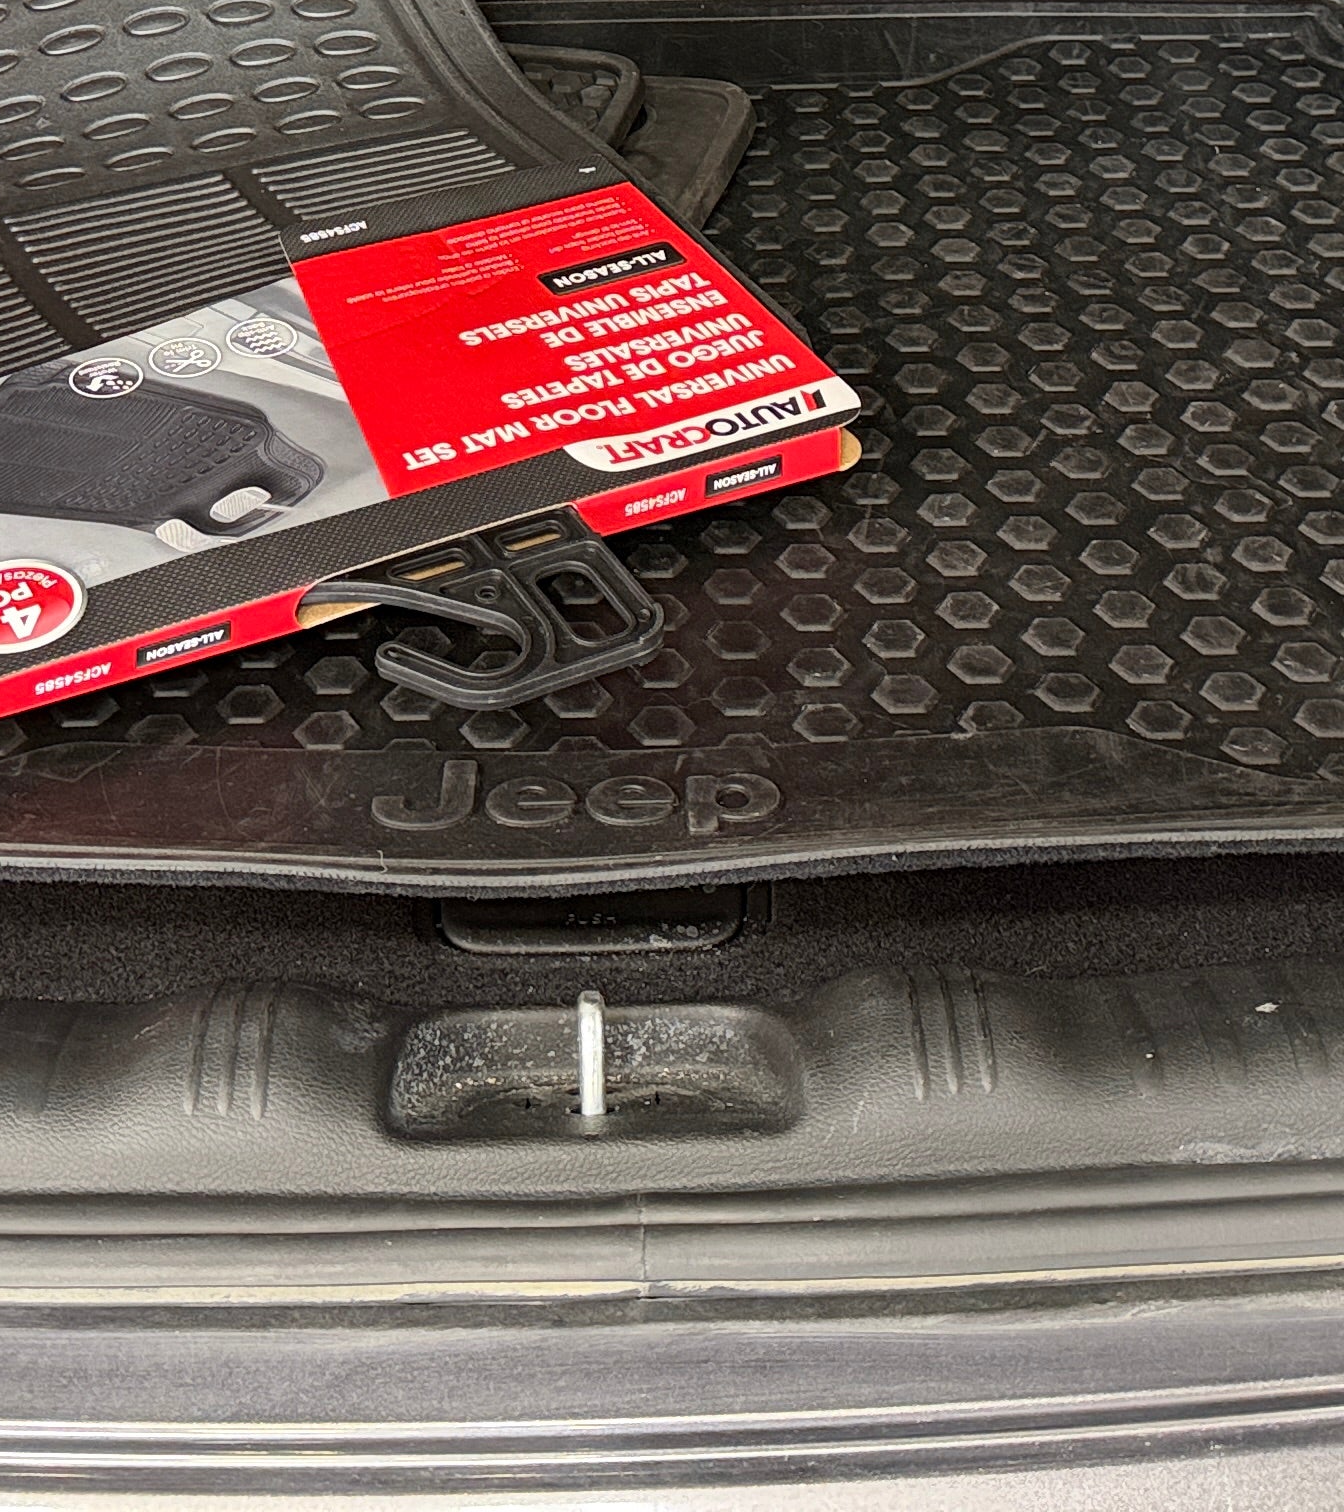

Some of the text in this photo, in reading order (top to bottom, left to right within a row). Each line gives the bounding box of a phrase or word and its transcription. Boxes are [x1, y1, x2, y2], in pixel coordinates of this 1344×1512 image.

[300, 219, 368, 243] ACFS4585
[553, 248, 667, 289] ALL-SEASON
[458, 271, 711, 347] TAPIS UNIVERSELS
[540, 288, 728, 349] ENSEMBLE DE
[563, 312, 753, 372] UNIVERSALES
[500, 328, 764, 410] JUEGO DE TAPETES
[402, 354, 795, 470] UNIVERSAL FLOOR MAT SET
[603, 396, 801, 465] AUTOCRAFT
[624, 487, 687, 516] ACFS4585
[713, 462, 778, 491] ALL-SEASON
[0, 604, 42, 639] 4
[146, 628, 225, 662] ALL-SEASON
[34, 662, 112, 696] ACFS4585
[370, 759, 783, 836] Jeep
